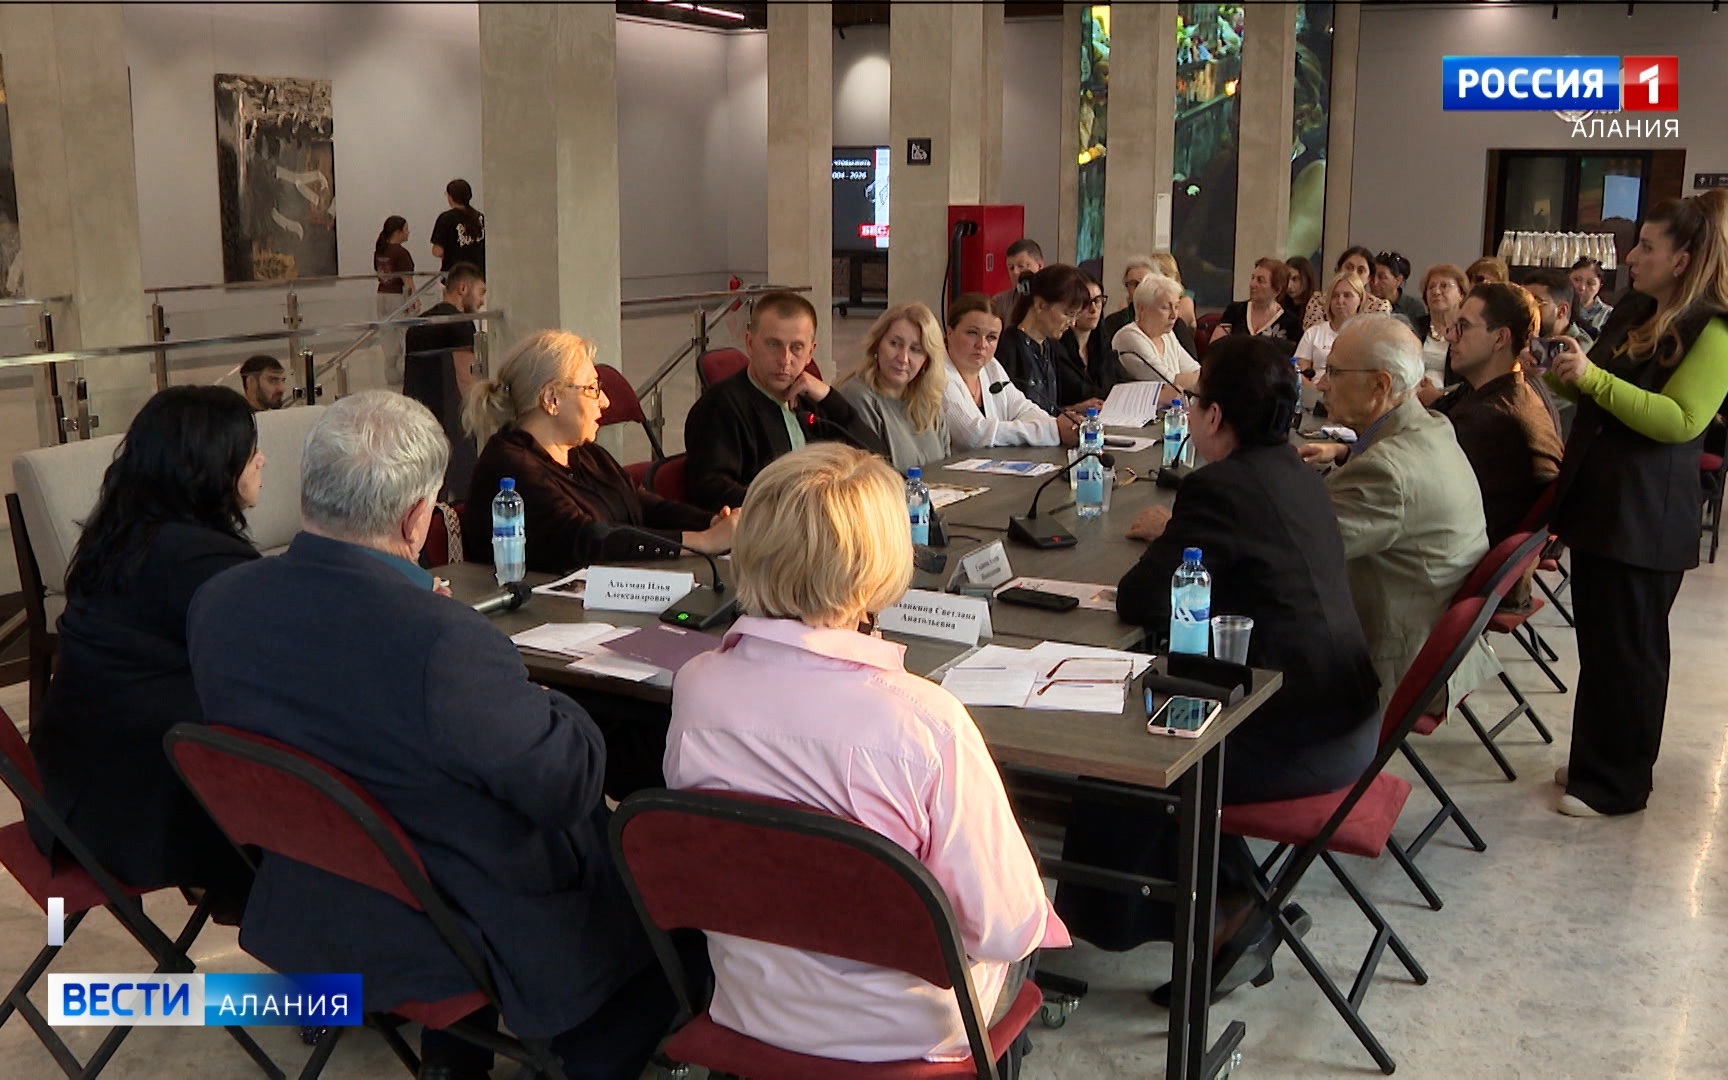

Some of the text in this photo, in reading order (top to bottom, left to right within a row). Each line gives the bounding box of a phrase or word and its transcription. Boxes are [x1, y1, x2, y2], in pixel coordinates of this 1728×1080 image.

[608, 579, 671, 591] Альтман Илья
[604, 591, 671, 602] Александрович
[934, 605, 976, 620] Светлана
[901, 613, 956, 629] Анатольевна
